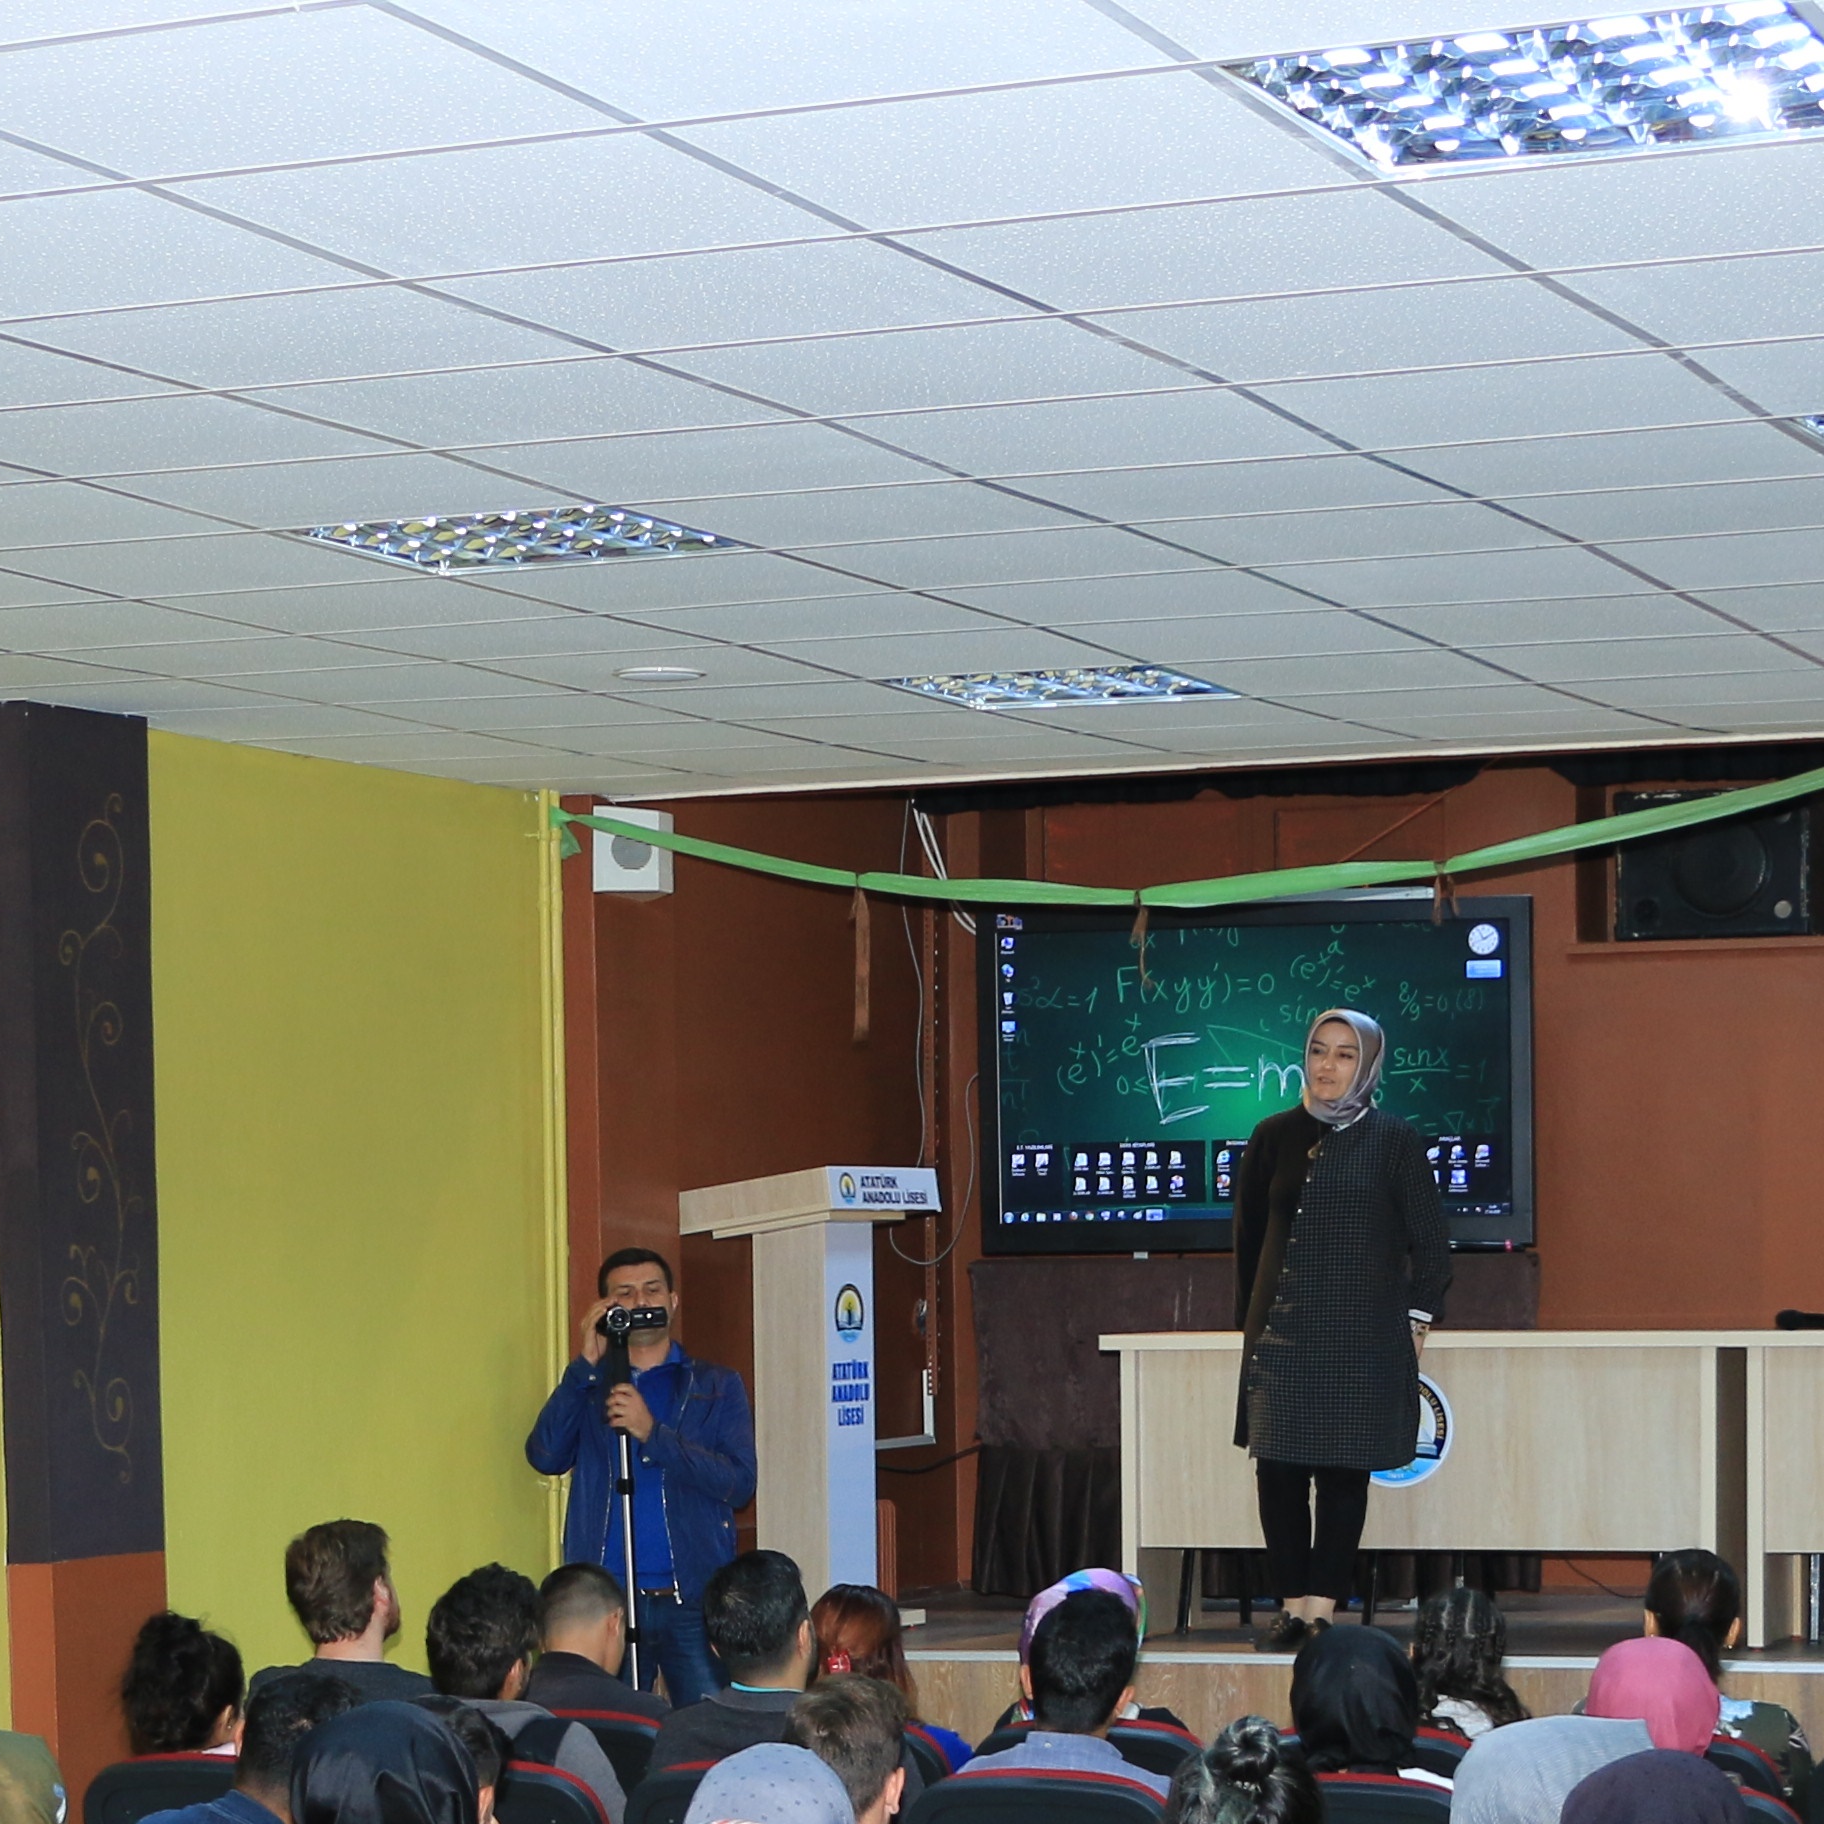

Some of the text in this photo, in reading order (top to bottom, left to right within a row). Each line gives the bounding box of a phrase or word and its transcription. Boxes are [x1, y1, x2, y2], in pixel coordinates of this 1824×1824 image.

[860, 1173, 898, 1189] ATATÜRK
[862, 1190, 901, 1204] ANADOLU
[832, 1359, 870, 1381] ATATÜRK
[832, 1383, 871, 1403] ANADOLU
[837, 1403, 864, 1427] LİSESİ
